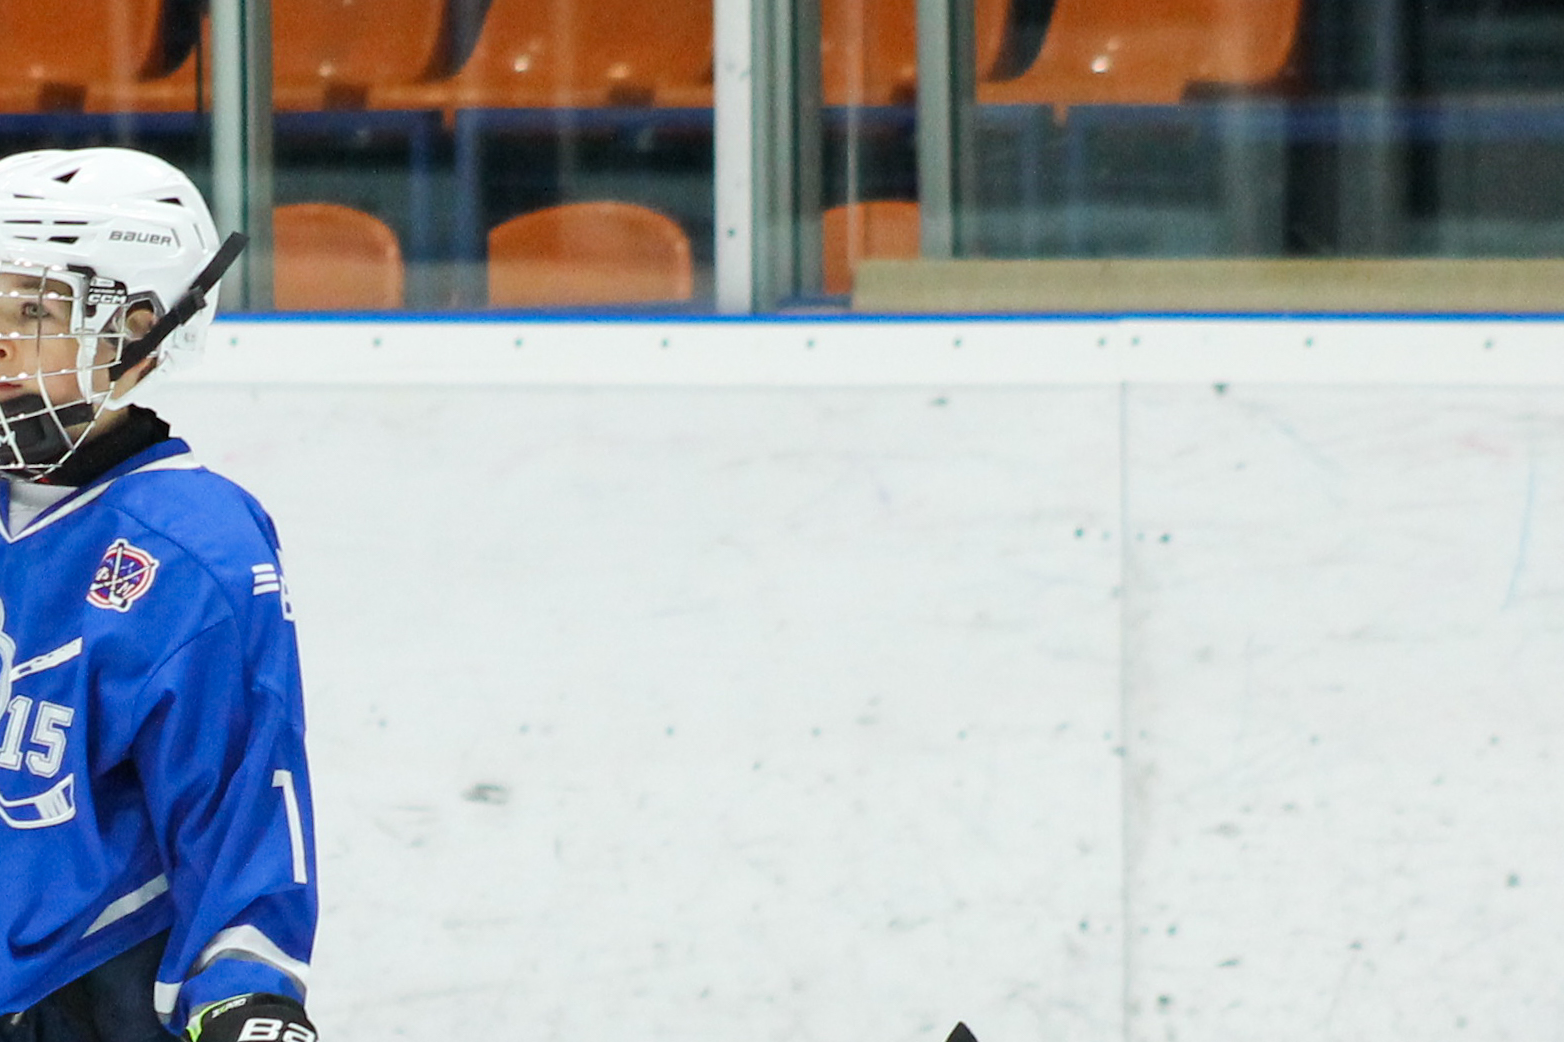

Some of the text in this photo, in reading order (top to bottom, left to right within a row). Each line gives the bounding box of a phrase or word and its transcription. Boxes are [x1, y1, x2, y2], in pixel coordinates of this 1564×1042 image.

[109, 230, 172, 246] BAUER
[87, 293, 127, 305] CCM
[271, 769, 308, 885] 1
